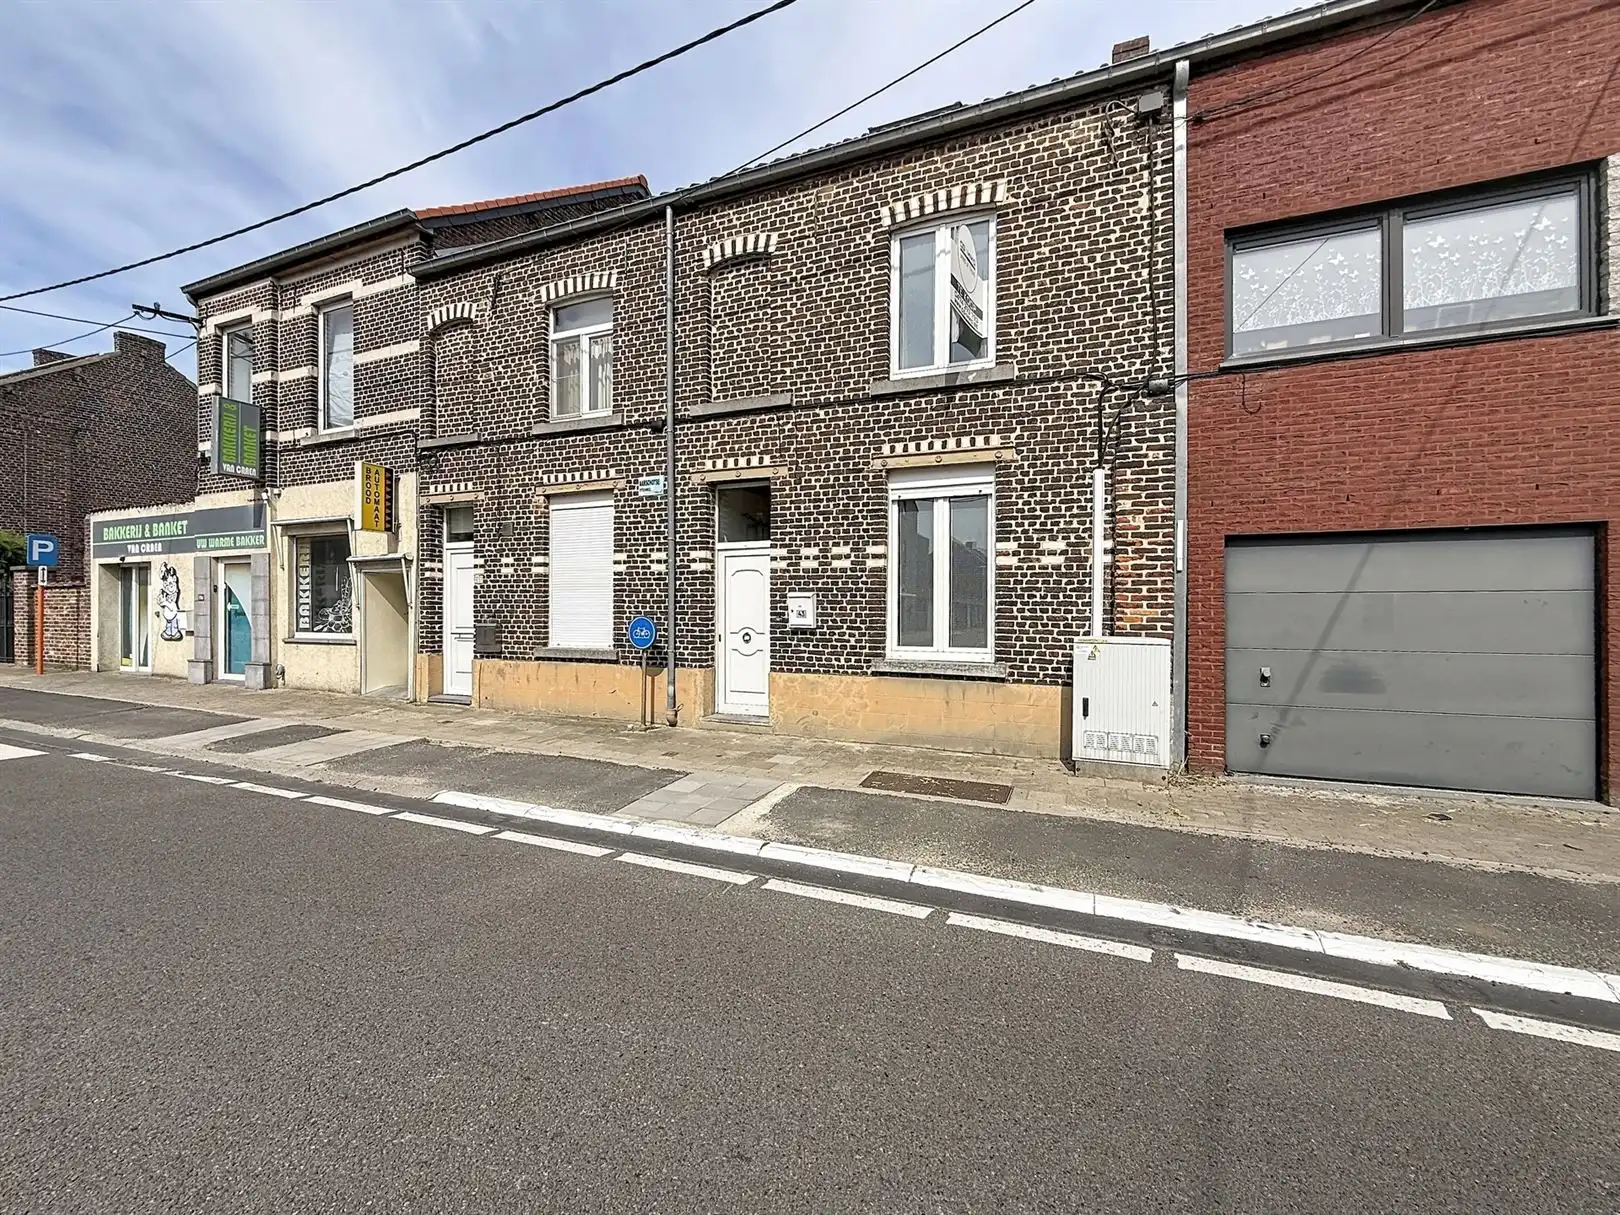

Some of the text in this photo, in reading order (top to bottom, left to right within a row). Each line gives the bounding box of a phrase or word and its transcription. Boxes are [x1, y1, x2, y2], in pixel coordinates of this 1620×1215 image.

[103, 520, 188, 541] BAKKERIJ & BANKET
[32, 539, 54, 561] P
[196, 534, 265, 549] UW WARME BAKKER
